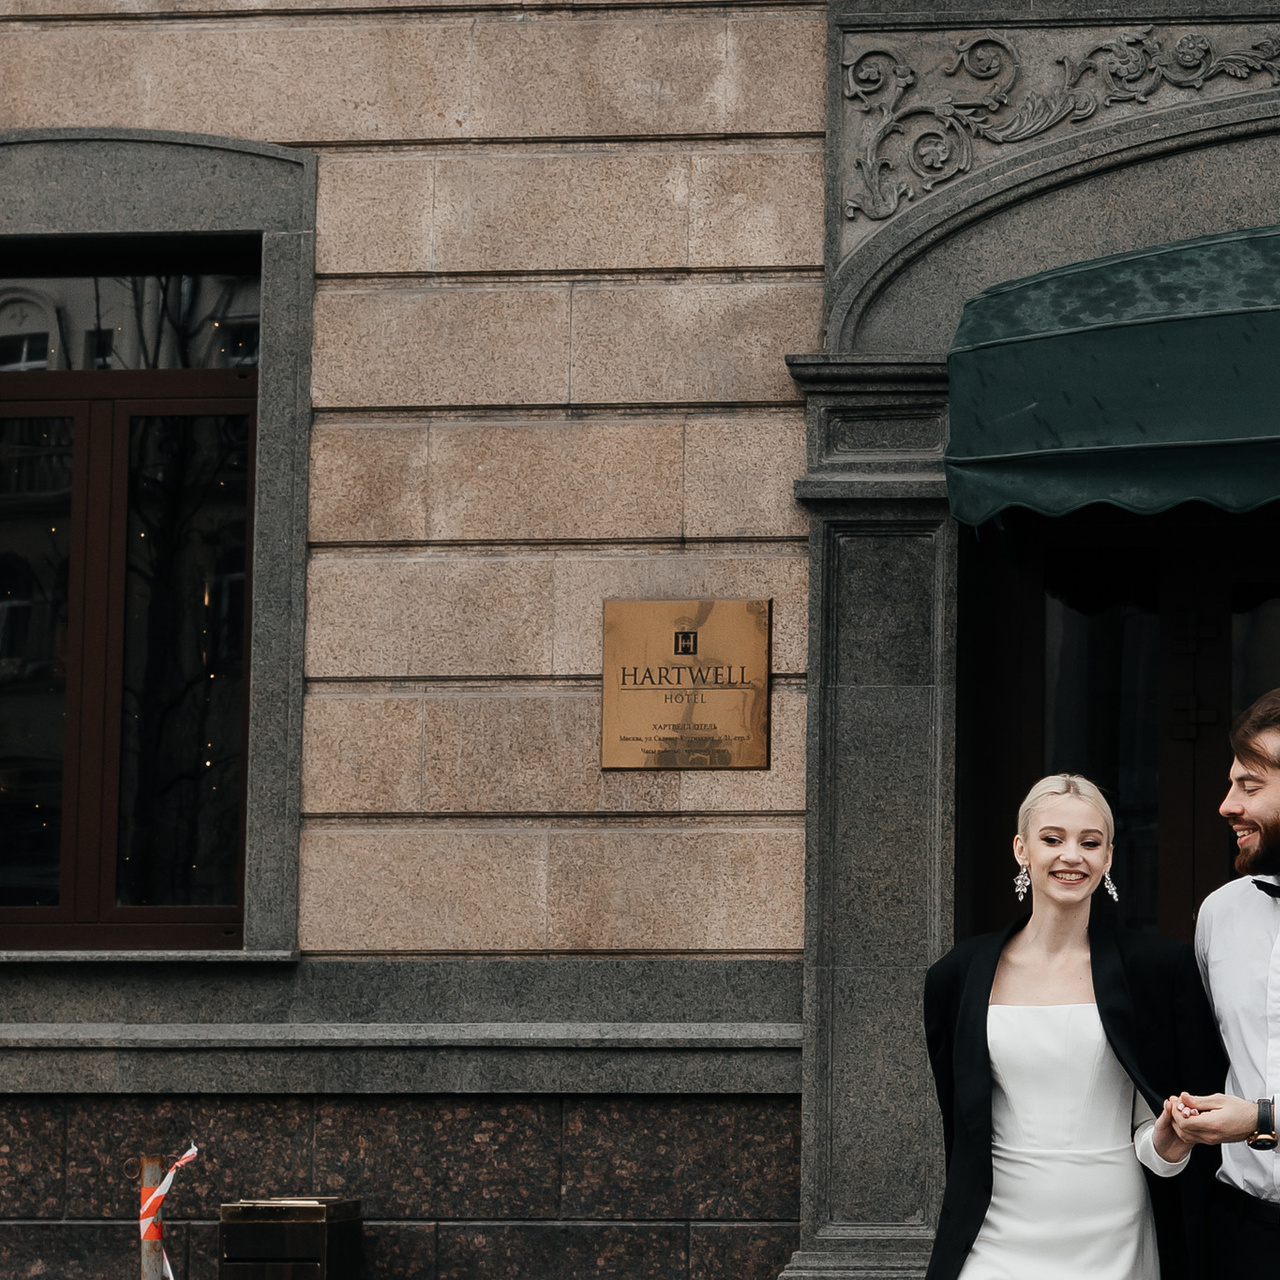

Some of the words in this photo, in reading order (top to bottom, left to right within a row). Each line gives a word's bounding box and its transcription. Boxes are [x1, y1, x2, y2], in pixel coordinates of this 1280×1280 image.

[621, 666, 751, 685] HARTWELL
[664, 694, 706, 704] HOTEL
[692, 723, 718, 731] ОТЕЛЬ
